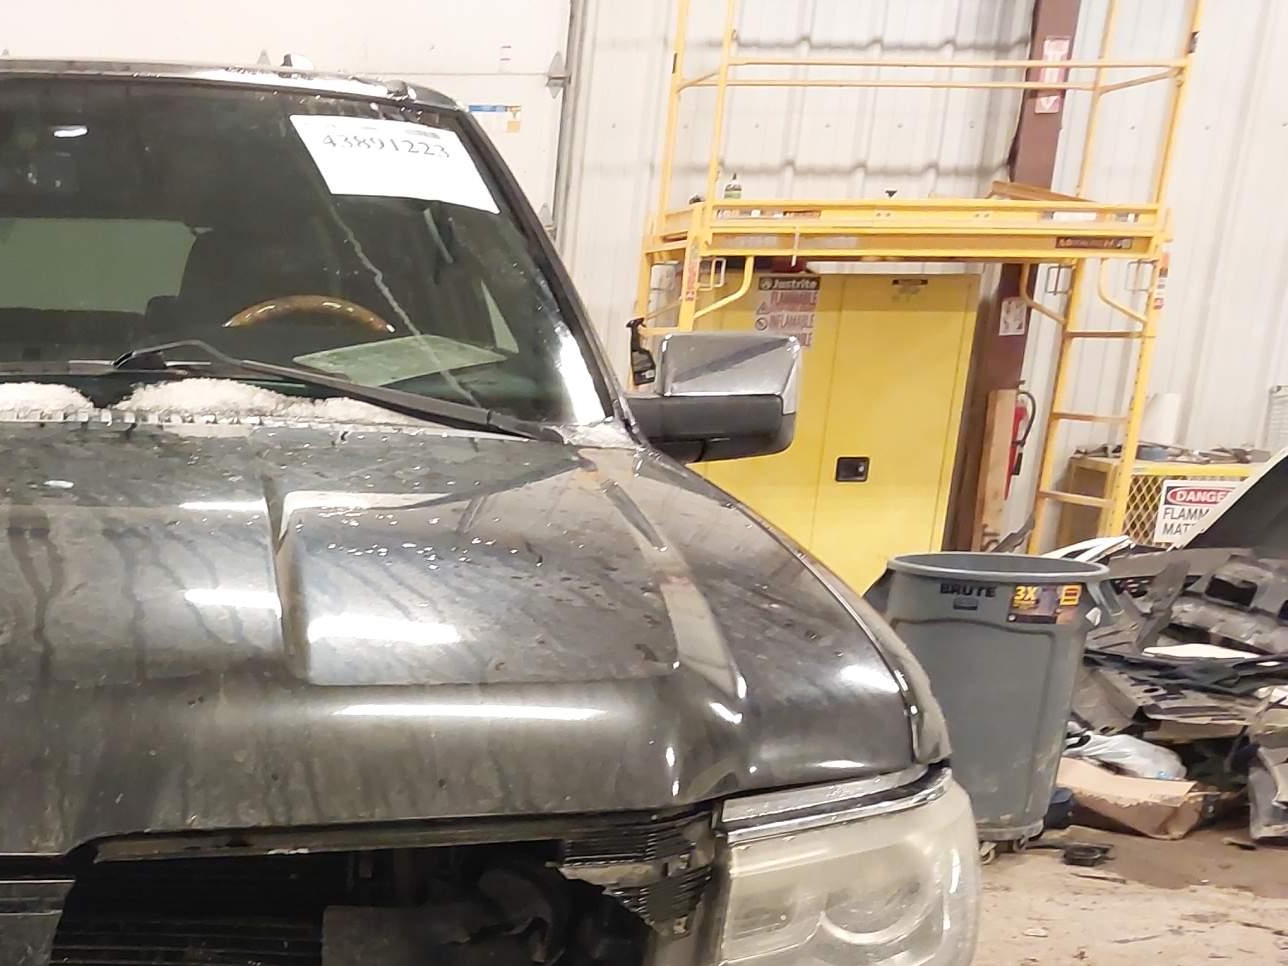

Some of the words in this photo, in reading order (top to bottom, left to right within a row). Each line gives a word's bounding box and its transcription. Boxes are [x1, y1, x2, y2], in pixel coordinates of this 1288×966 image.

[1174, 490, 1231, 503] DANGE
[1161, 522, 1196, 535] MAT
[940, 583, 997, 598] BRUTE
[1014, 585, 1038, 601] 3X
